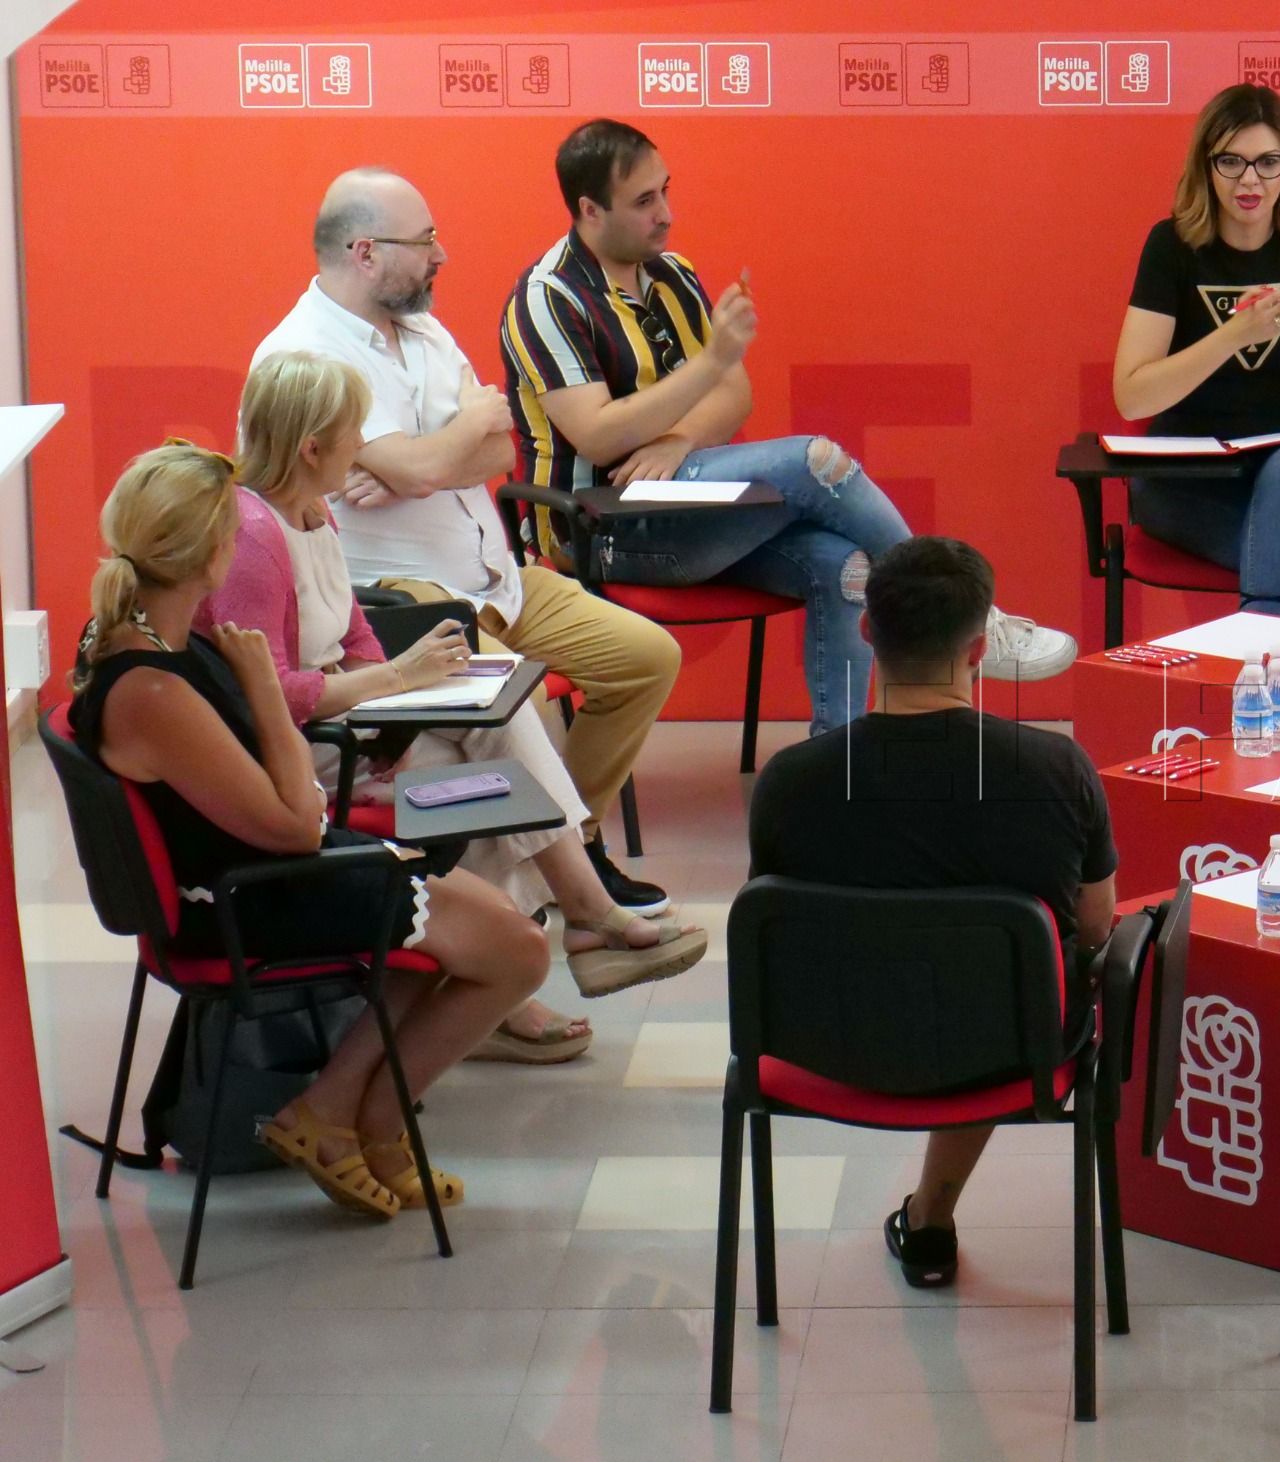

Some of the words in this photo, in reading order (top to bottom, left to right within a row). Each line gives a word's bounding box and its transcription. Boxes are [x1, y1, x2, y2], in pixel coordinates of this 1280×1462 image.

[45, 60, 90, 72] Melilla
[246, 60, 290, 72] Melilla
[445, 60, 490, 72] Melilla
[645, 59, 689, 71] Melilla
[845, 59, 889, 71] Melilla
[1045, 57, 1089, 70] Melilla
[46, 74, 100, 93] PSOE
[246, 74, 298, 93] PSOE
[445, 74, 498, 93] PSOE
[645, 73, 698, 92] PSOE
[845, 73, 898, 92] PSOE
[1045, 71, 1097, 91] PSOE
